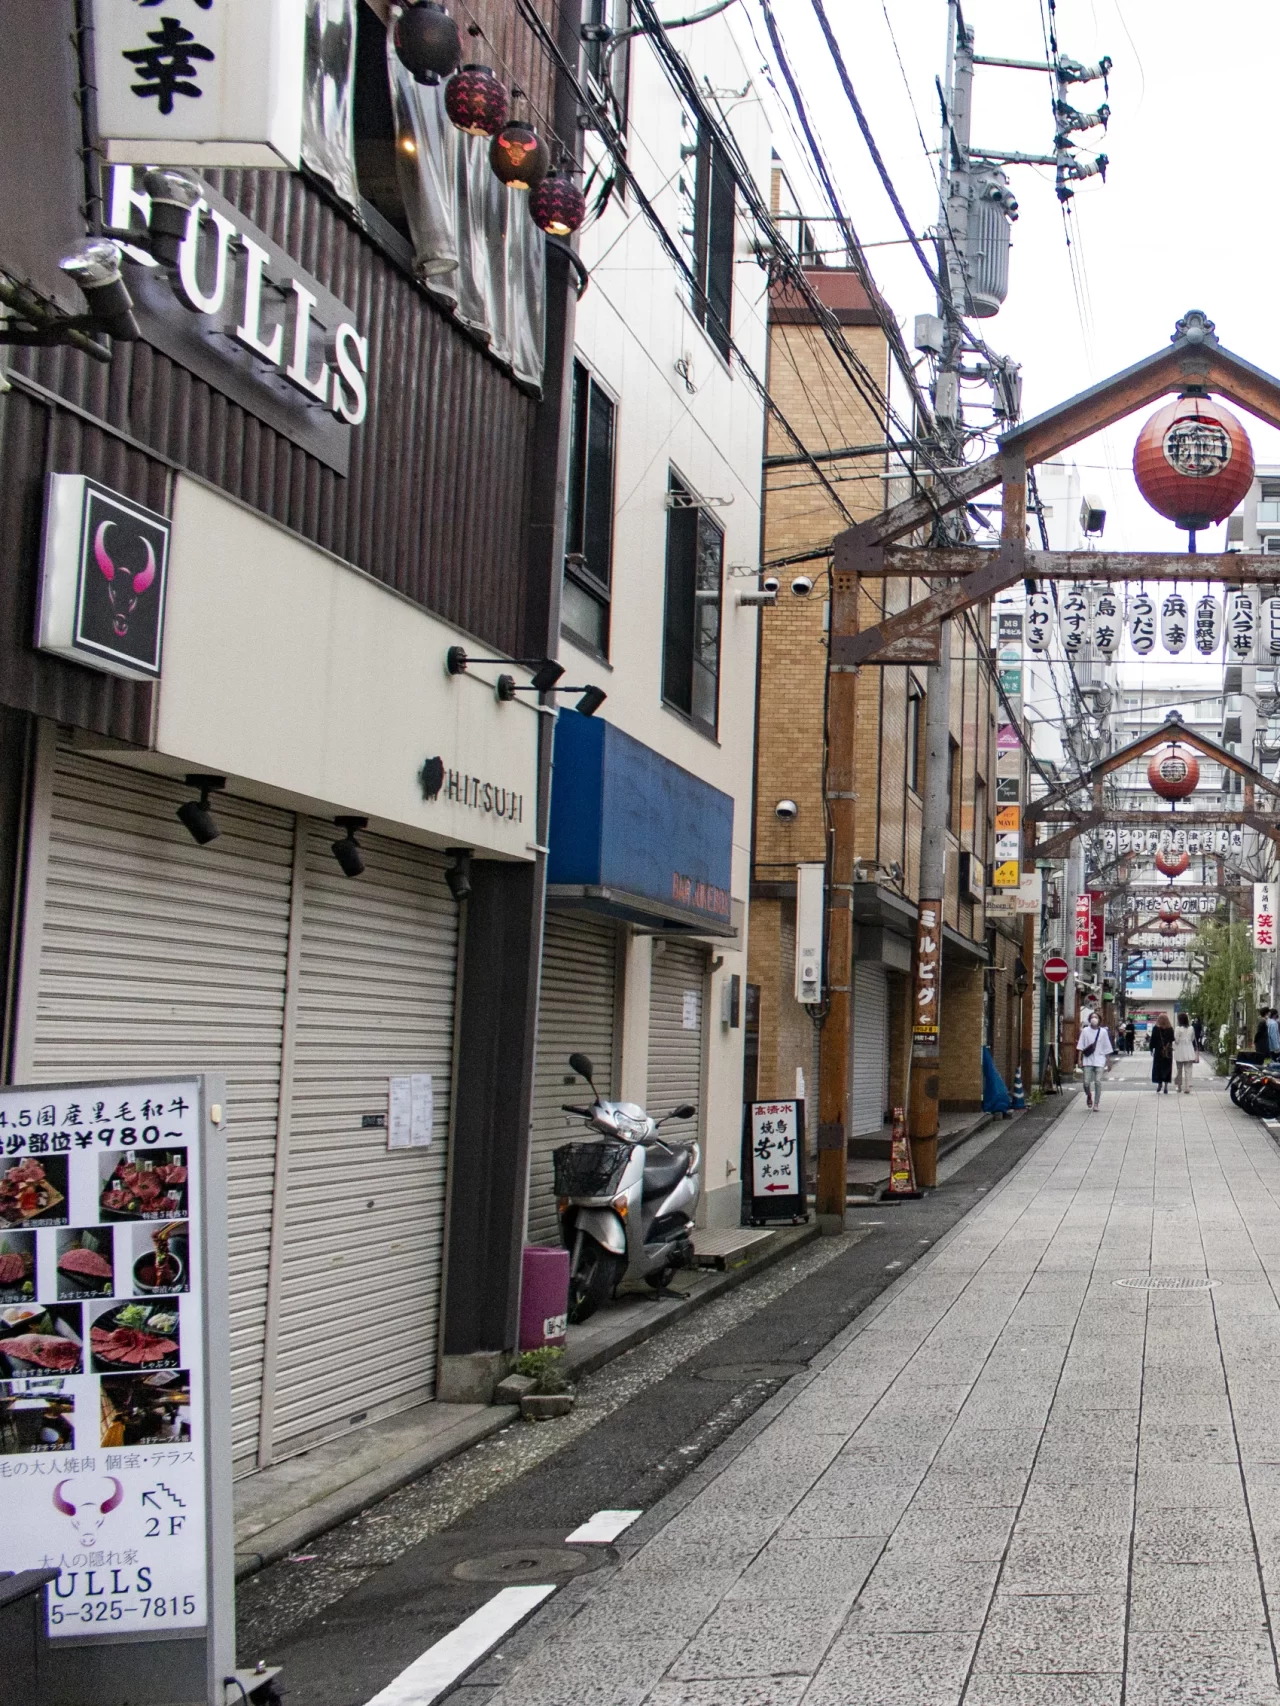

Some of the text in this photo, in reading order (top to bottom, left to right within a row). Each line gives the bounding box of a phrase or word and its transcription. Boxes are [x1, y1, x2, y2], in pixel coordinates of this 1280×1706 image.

[122, 0, 215, 115] 幸
[1028, 596, 1049, 644] いわき
[1133, 598, 1154, 650] うだつ
[1163, 598, 1187, 646] 浜幸
[448, 768, 523, 823] HITSUJI
[918, 910, 935, 1005] ミルピグ
[60, 1290, 113, 1299] みすじステーキ
[141, 1359, 178, 1368] しゃぶタン
[105, 1451, 196, 1471] 個室・テラス
[37, 1549, 139, 1569] 大人の隠れ家
[51, 1595, 196, 1624] 5-325-7815
